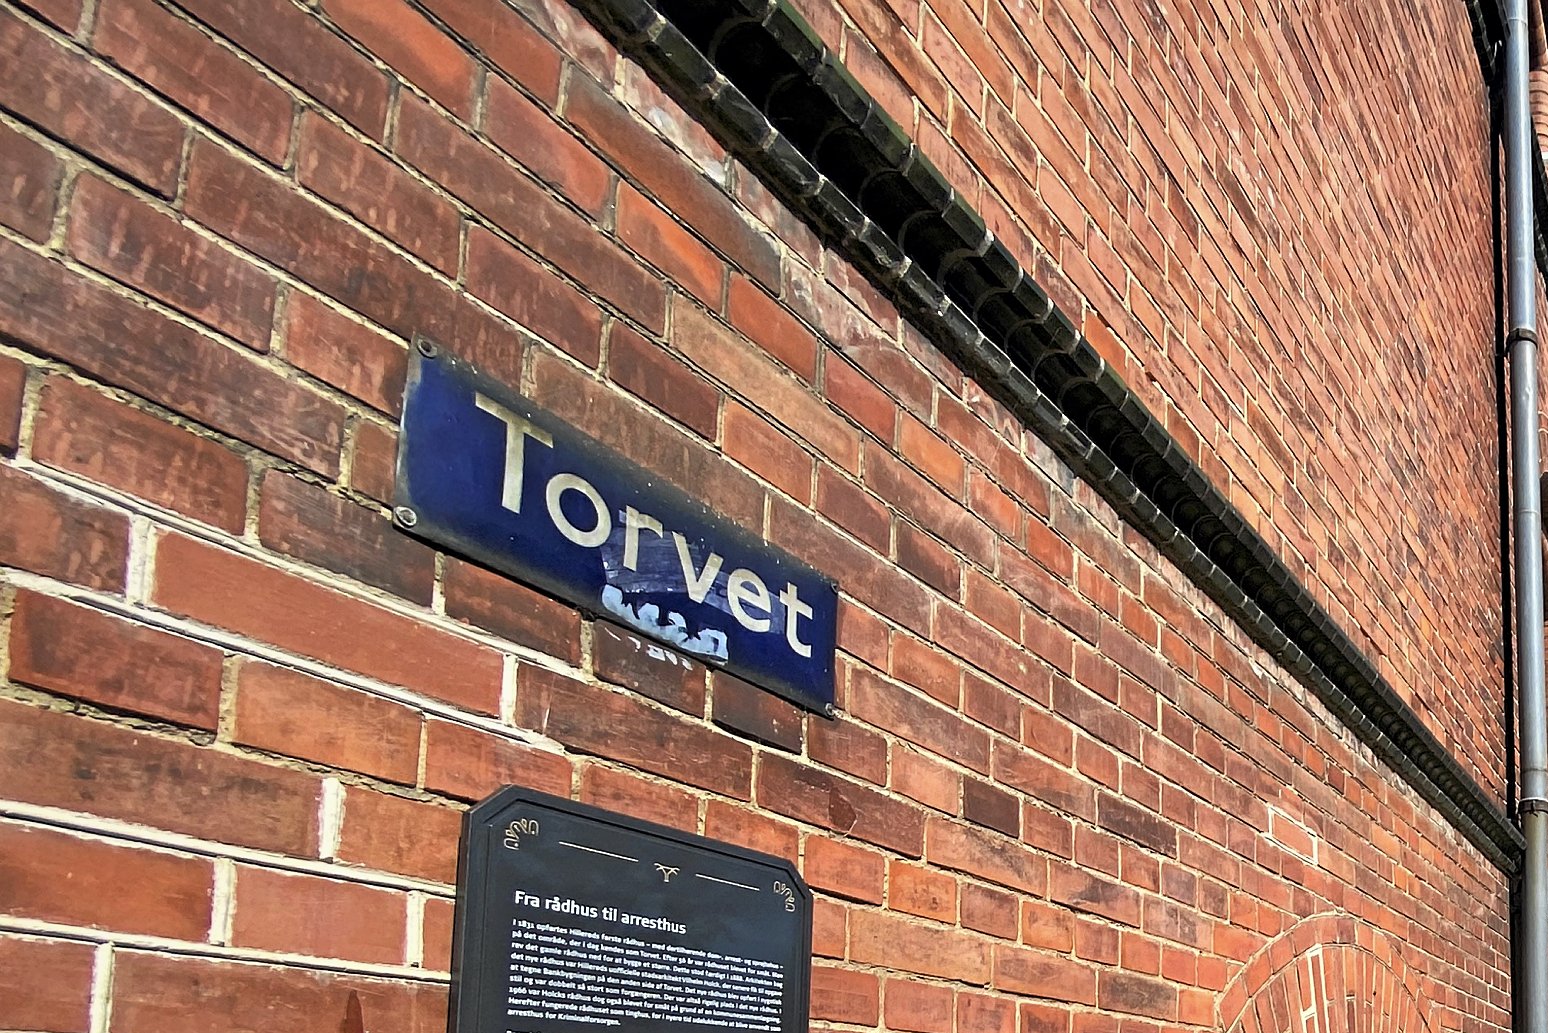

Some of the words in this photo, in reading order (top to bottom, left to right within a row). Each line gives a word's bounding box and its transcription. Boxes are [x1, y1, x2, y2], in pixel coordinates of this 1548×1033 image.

[475, 391, 814, 658] Torvet
[514, 889, 541, 908] Fra
[545, 896, 599, 918] rådhus
[602, 906, 618, 922] til
[621, 913, 687, 934] arresthus
